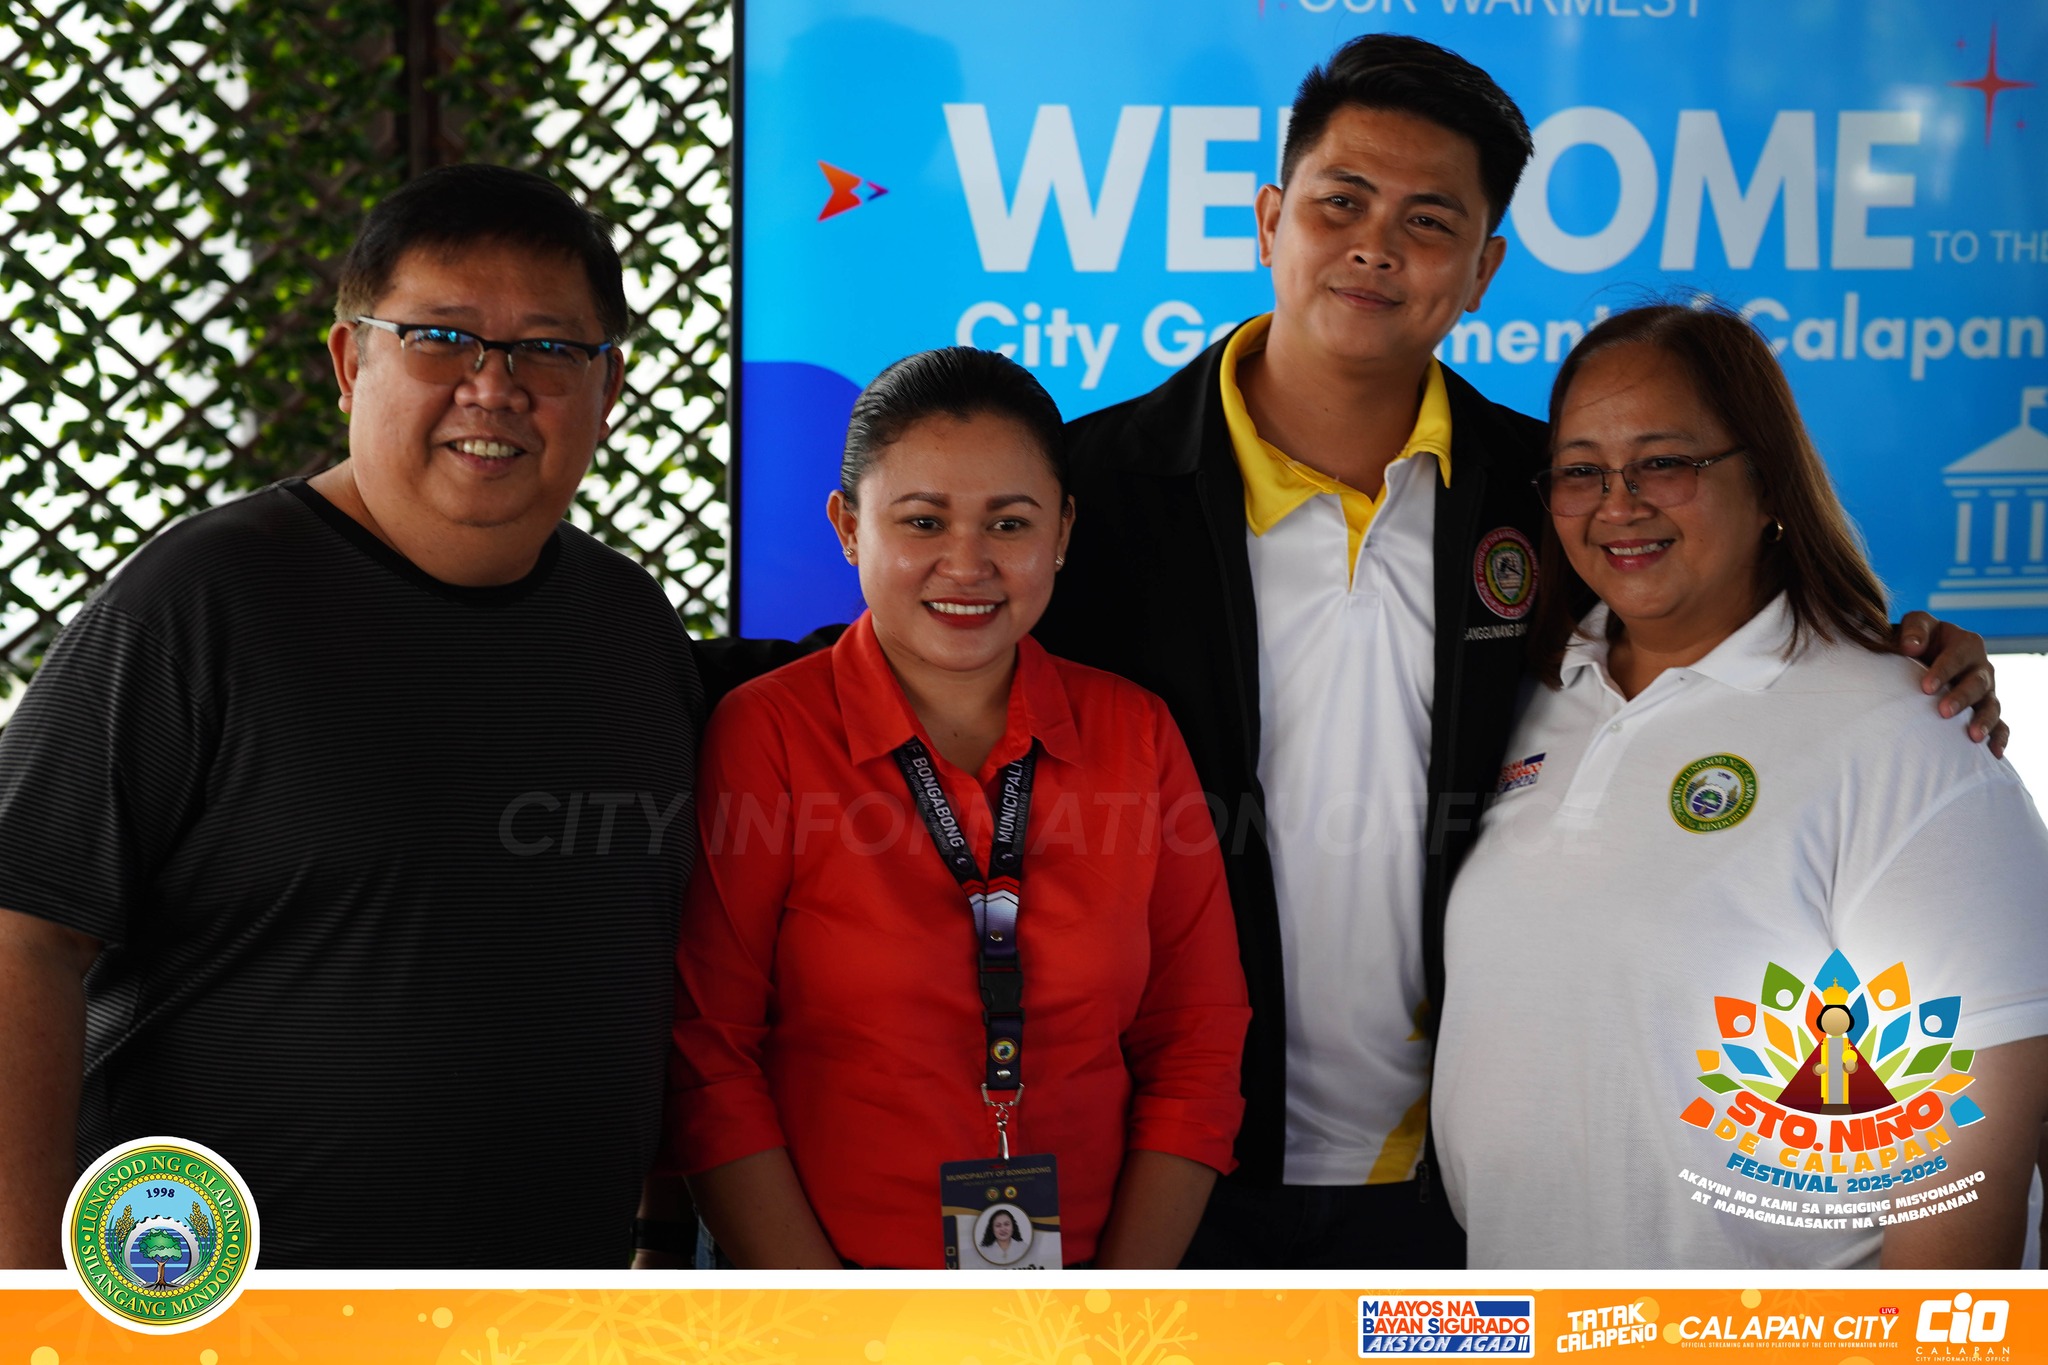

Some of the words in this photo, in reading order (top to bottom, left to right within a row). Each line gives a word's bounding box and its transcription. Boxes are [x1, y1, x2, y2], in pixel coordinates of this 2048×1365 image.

[942, 104, 1922, 273] WEOME
[1928, 230, 1979, 264] TO
[955, 300, 1120, 390] City
[1740, 293, 2046, 381] Calapan
[912, 756, 964, 848] BONGABONG
